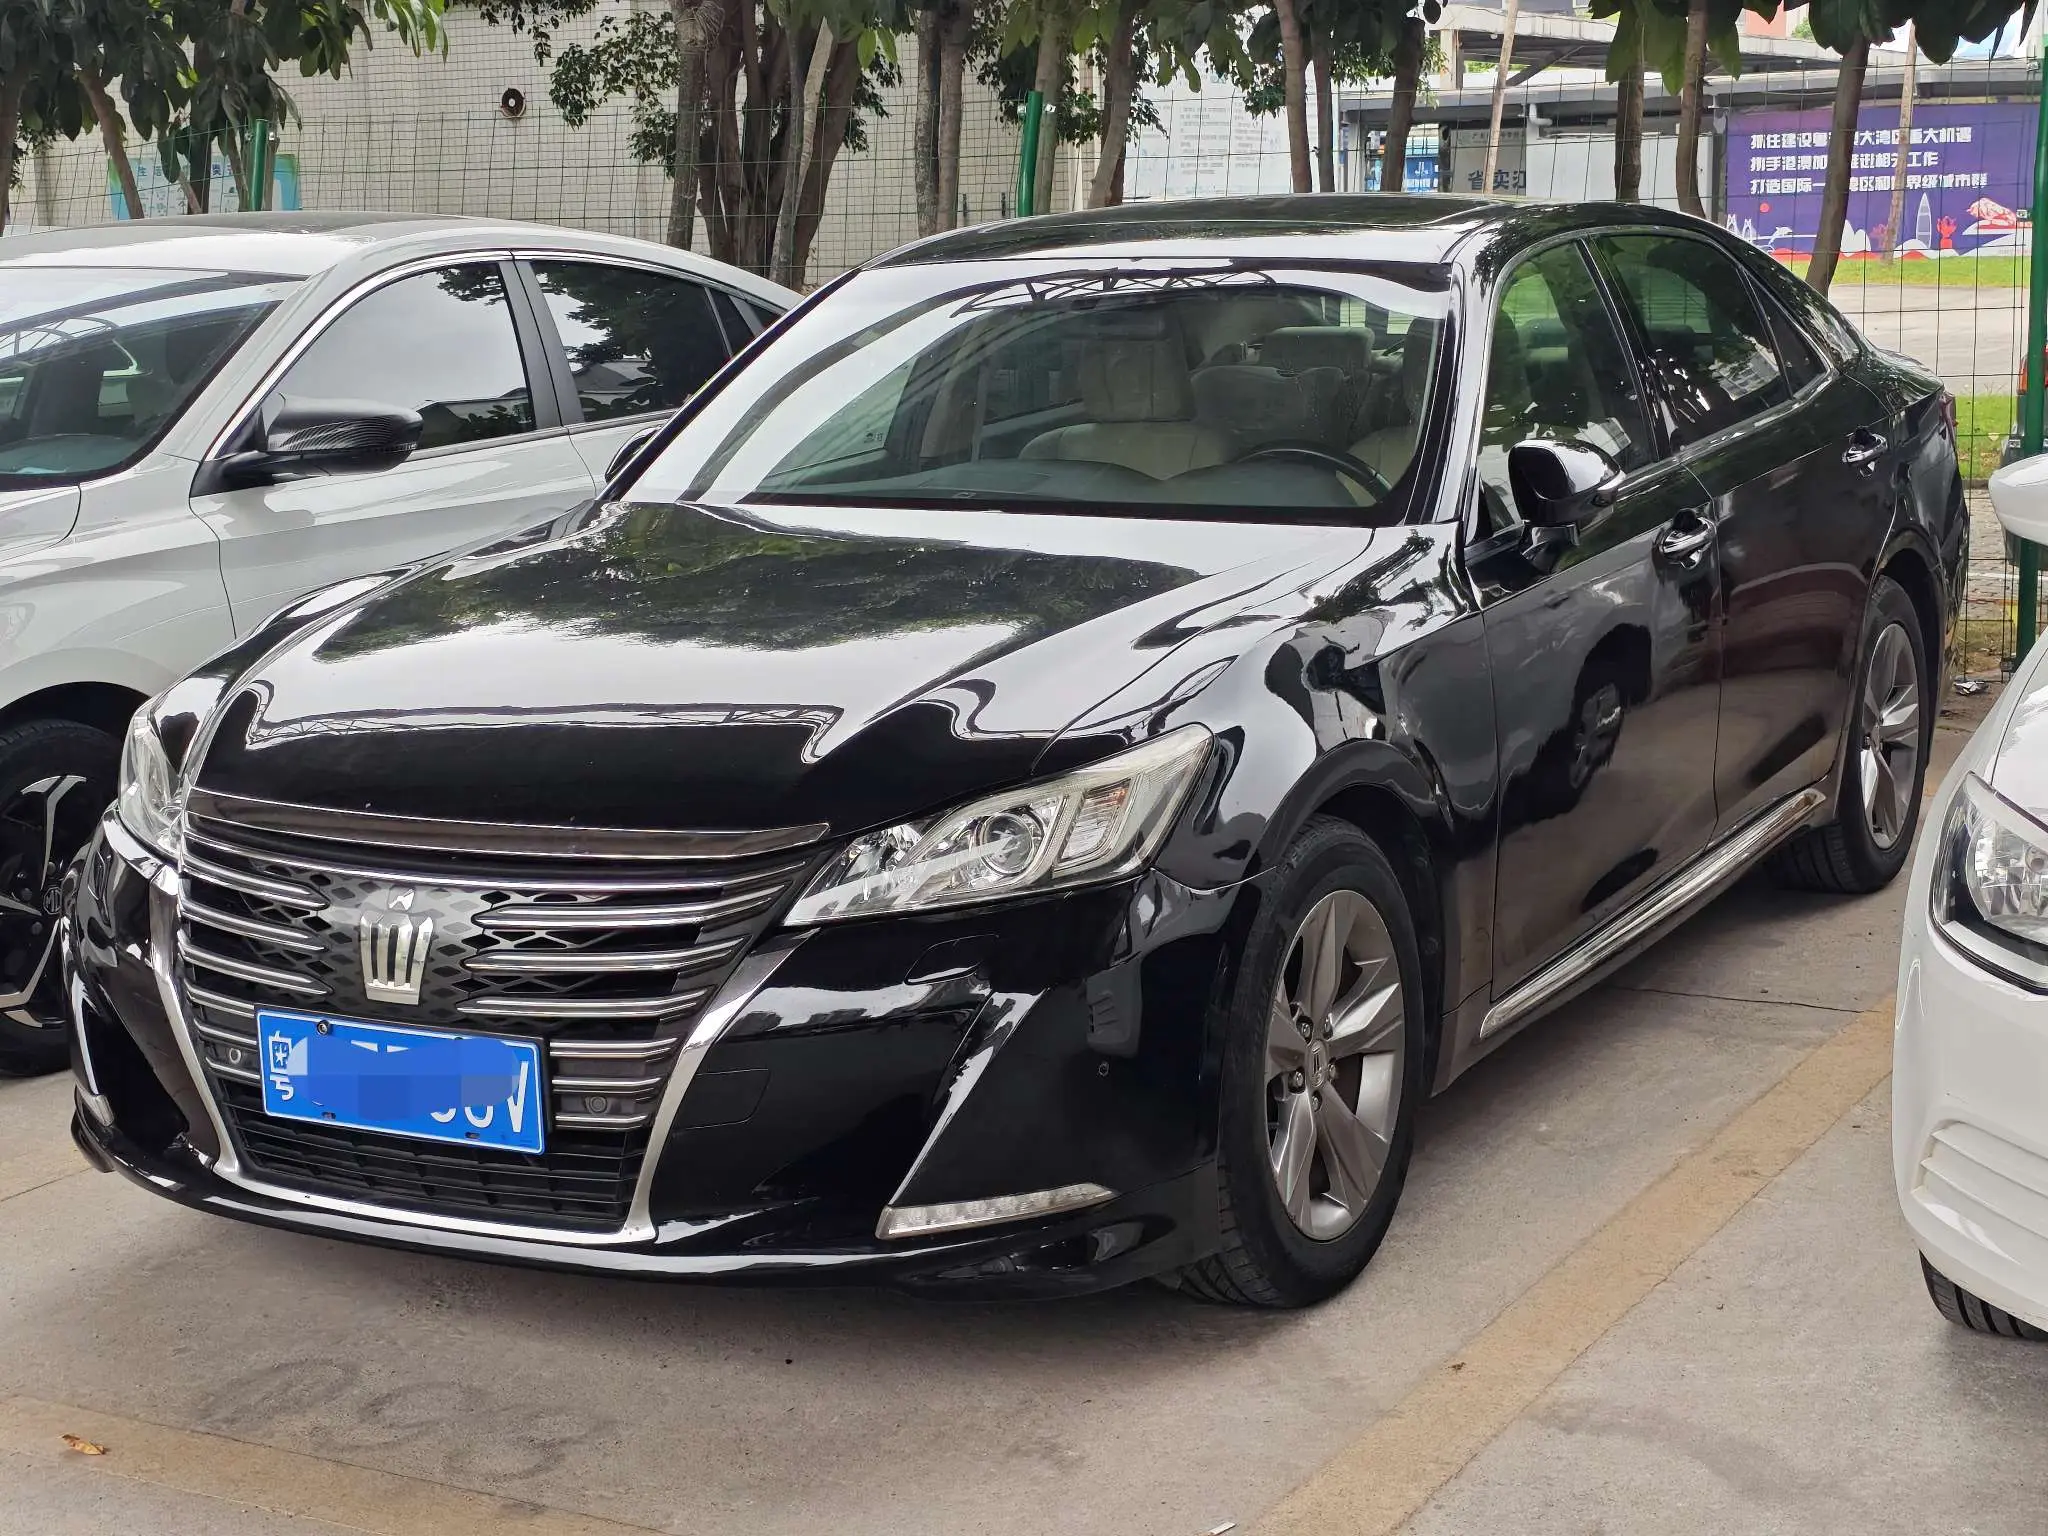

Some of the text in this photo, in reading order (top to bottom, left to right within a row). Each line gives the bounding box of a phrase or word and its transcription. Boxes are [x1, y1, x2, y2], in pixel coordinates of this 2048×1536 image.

[1750, 127, 1972, 149] 抓住建设粤大湾区重大机遇
[1750, 172, 1988, 194] 打造国际一湾区和界级城市群
